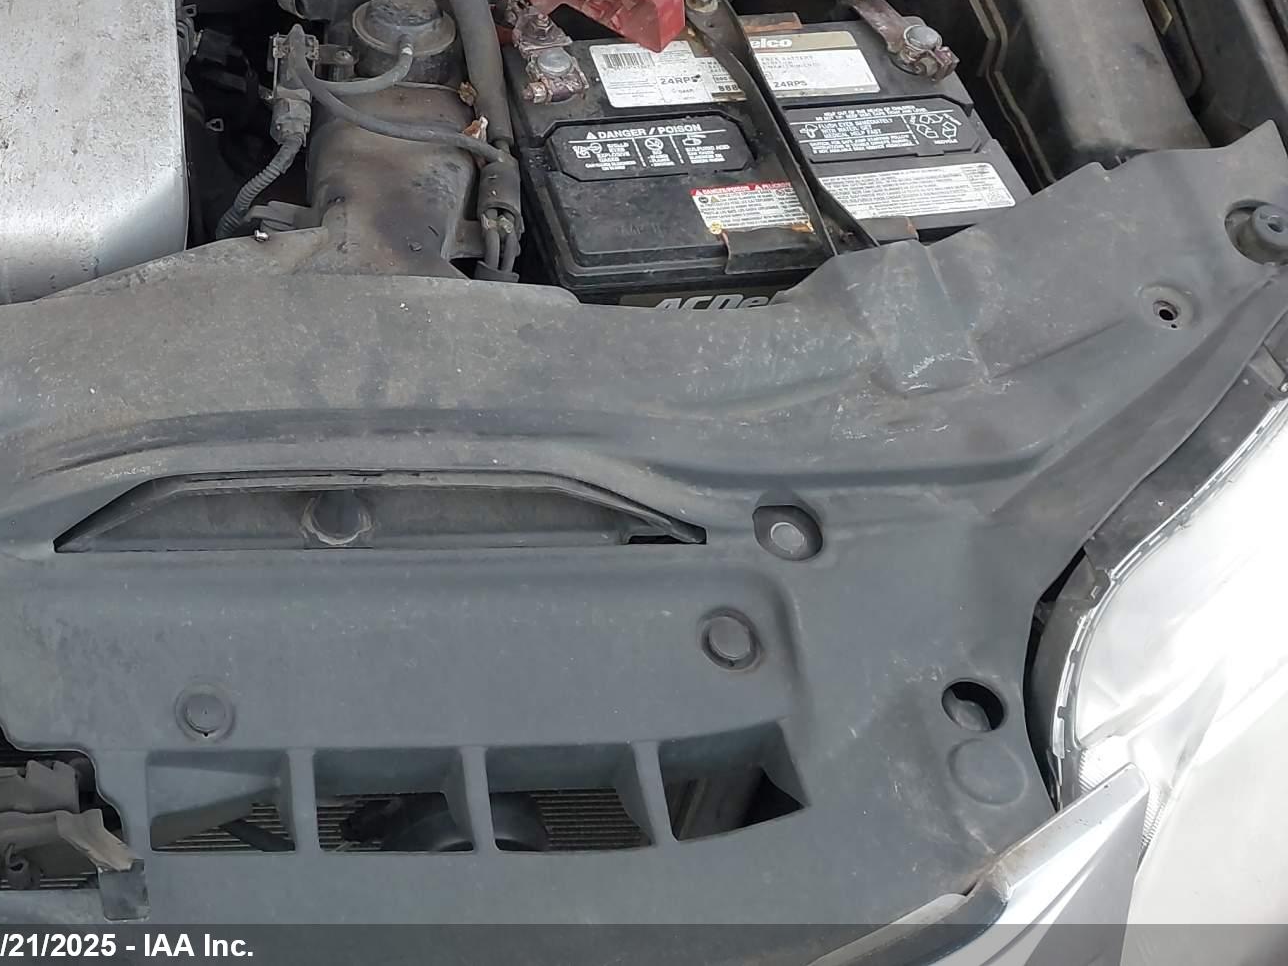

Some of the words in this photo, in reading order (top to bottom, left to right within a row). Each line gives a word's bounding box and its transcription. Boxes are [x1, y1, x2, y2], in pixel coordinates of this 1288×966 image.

[774, 80, 808, 88] 24RPS
[598, 128, 646, 139] DANGER
[657, 124, 702, 134] POISON
